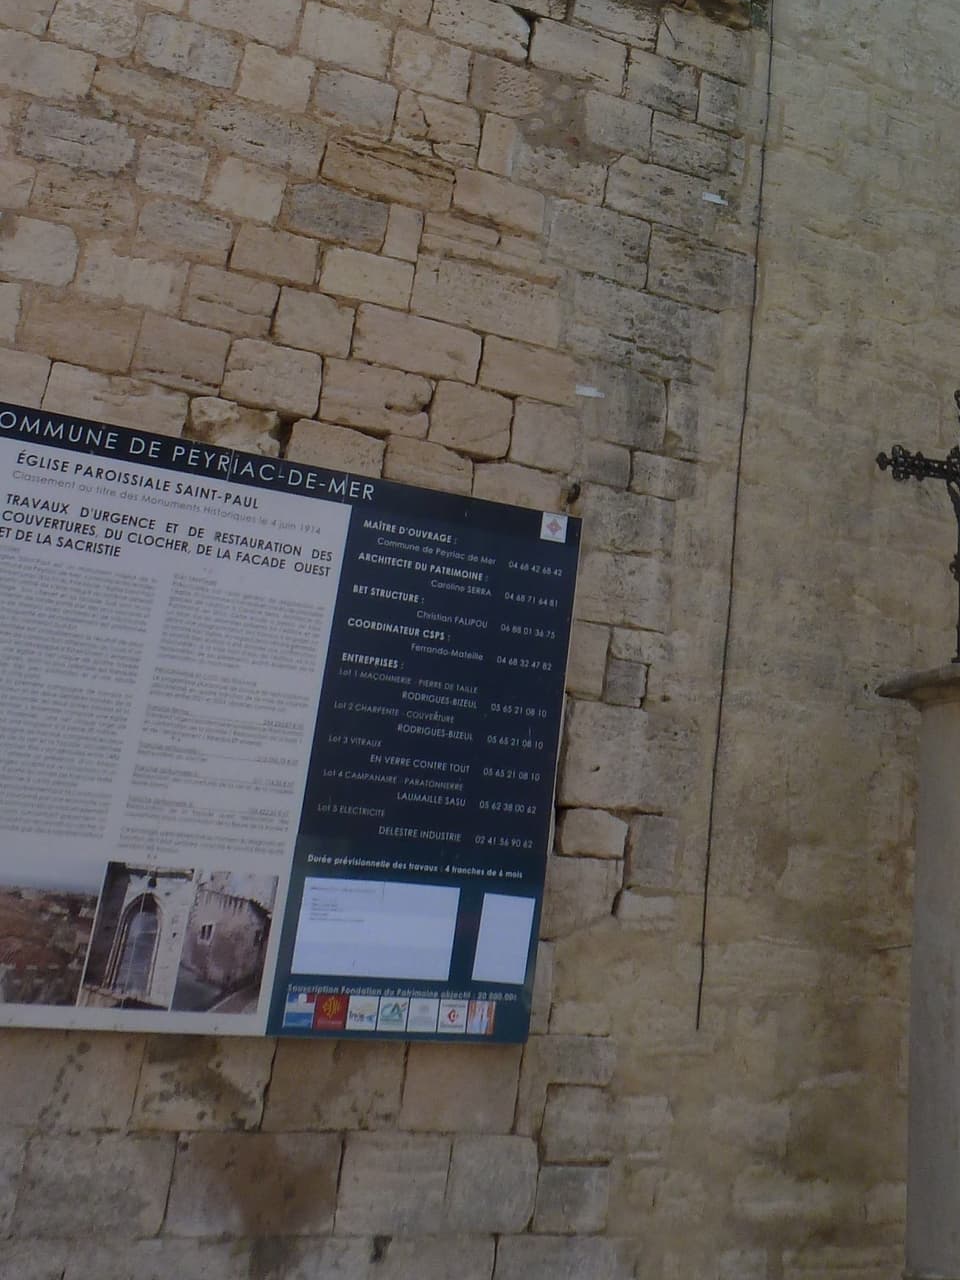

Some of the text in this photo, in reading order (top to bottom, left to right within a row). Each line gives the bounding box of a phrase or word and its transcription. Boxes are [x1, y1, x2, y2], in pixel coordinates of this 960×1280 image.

[16, 450, 259, 509] ÉGLISE PAROISSIALE SAINT-PAUL
[130, 437, 161, 458] DE
[172, 446, 375, 501] PEYRIAC-DE-MER
[12, 471, 76, 490] Classement
[80, 482, 93, 493] au
[96, 484, 116, 497] titre
[120, 491, 138, 502] des
[142, 494, 201, 513] Monuments
[204, 506, 257, 523] Historiques
[6, 493, 333, 562] TRAVAUX D'URGENCE ET DE RESTAURATION DES
[364, 520, 396, 533] MAÎTRE
[399, 526, 452, 544] D'OUVRAGE
[0, 526, 122, 558] ET DE LA SACRISTIE
[104, 526, 123, 541] DU
[127, 532, 191, 554] CLOCHER,
[196, 544, 213, 556] DE
[216, 548, 231, 560] LA
[236, 551, 286, 570] FACADE
[294, 561, 331, 577] OUEST
[377, 537, 496, 565] Commune de Peyriac de Mer
[358, 552, 413, 569] ARCHITECTE
[415, 562, 427, 571] DU
[430, 564, 483, 582] PATRIMOINE
[353, 584, 368, 595] BET
[371, 587, 419, 604] STRUCTURE
[431, 579, 492, 597] Caroline SERRA
[348, 618, 420, 637] COORDINATEUR
[423, 630, 445, 641] CSPS
[416, 610, 452, 623] Christian
[342, 652, 398, 669] ENTREPRISES
[370, 754, 470, 774] EN VERRE CONTRE TOUT
